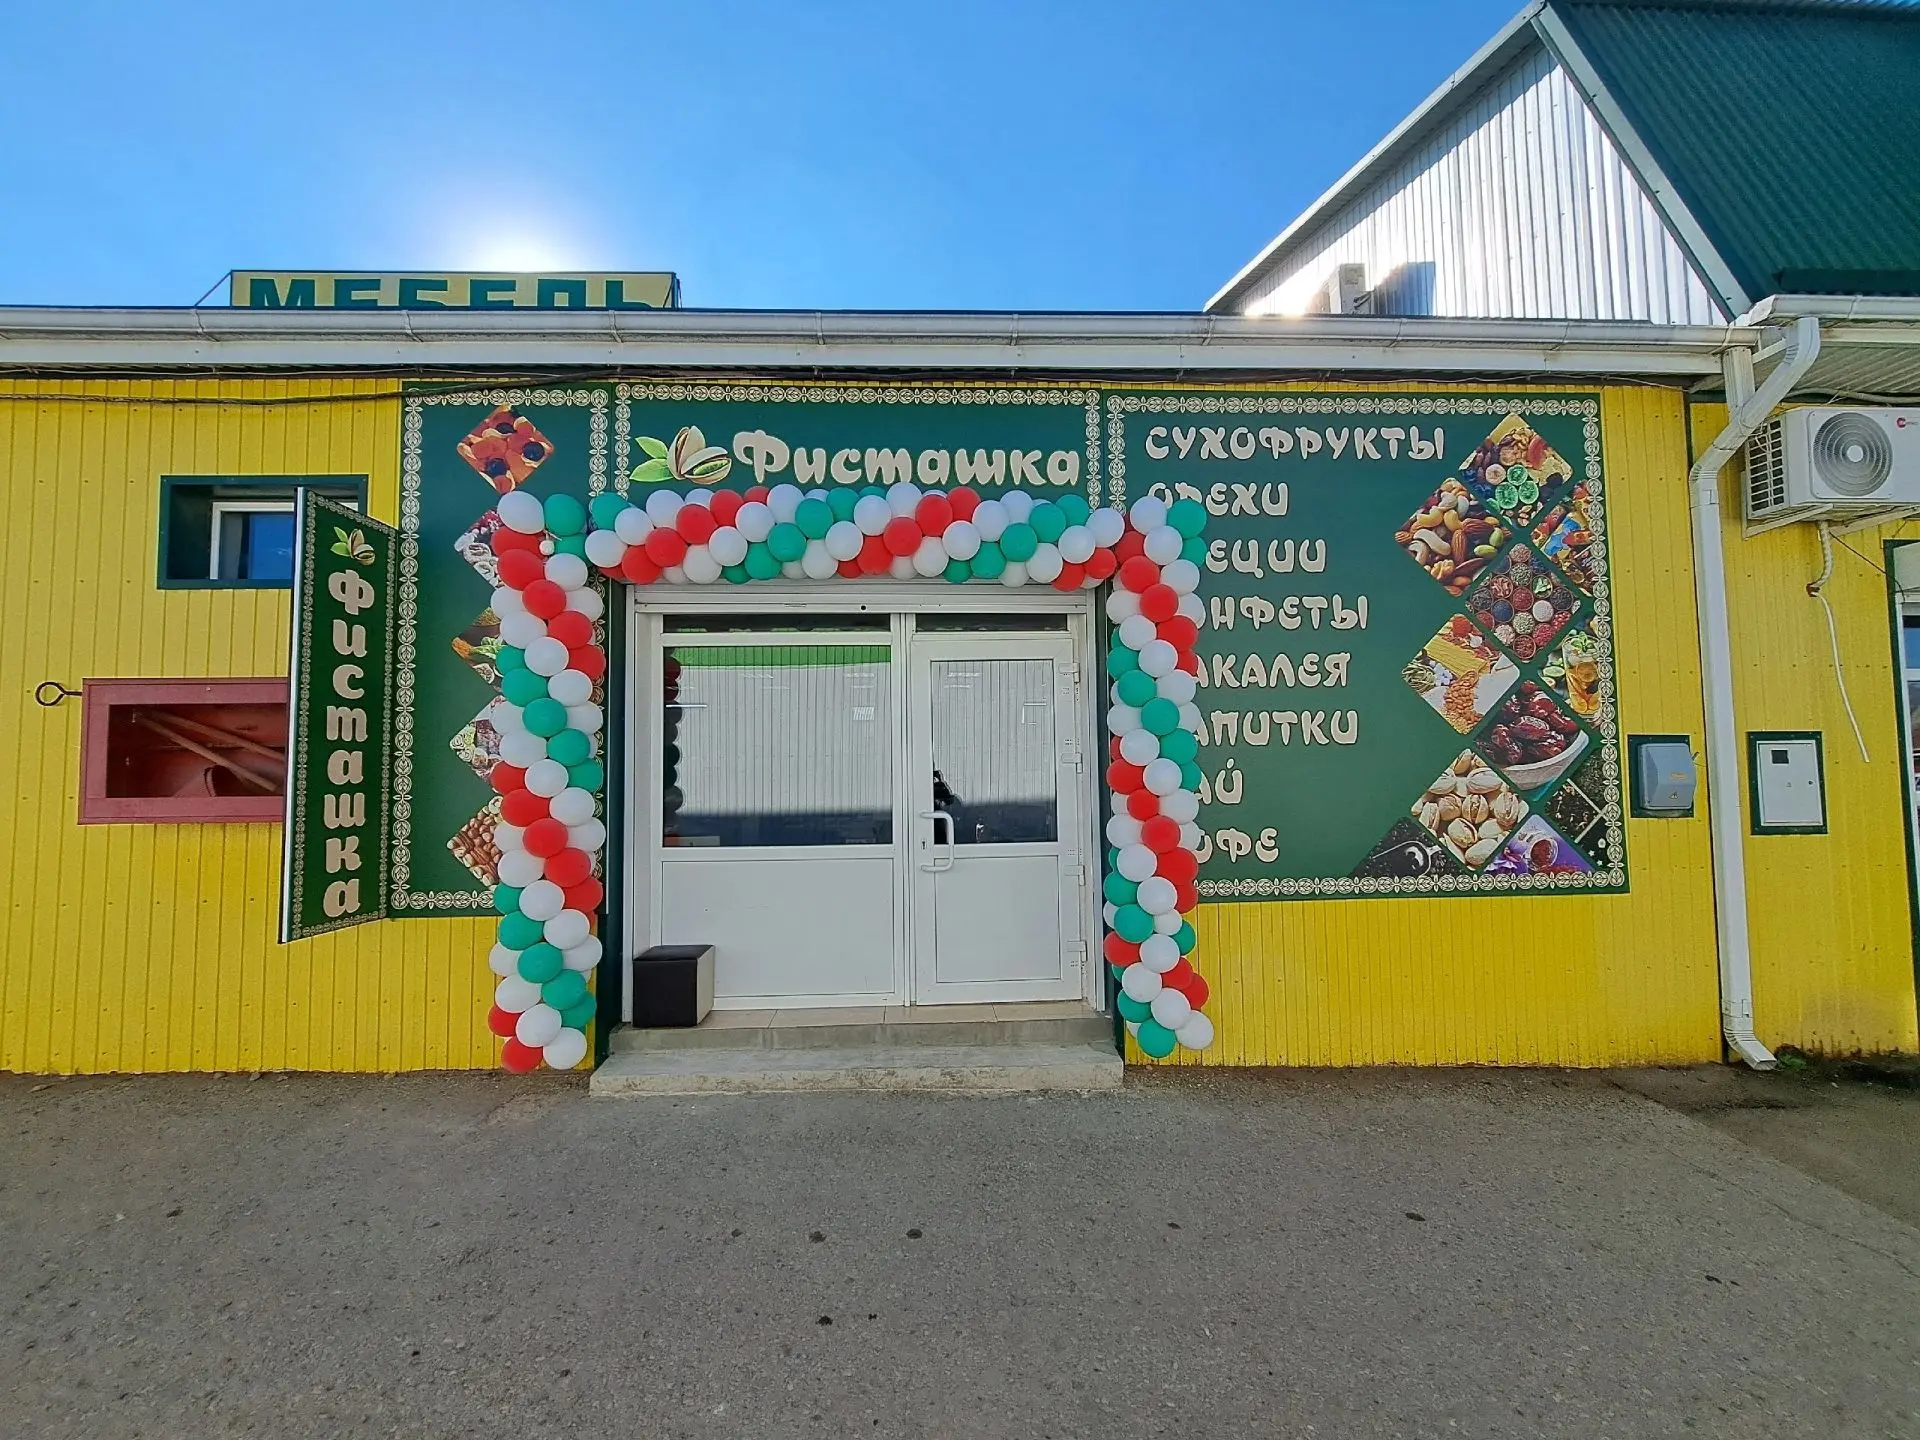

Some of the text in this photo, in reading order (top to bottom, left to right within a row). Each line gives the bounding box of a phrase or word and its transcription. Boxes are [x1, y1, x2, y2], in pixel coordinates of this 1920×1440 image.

[732, 428, 1080, 486] Фисташка
[1145, 425, 1446, 460] СУХОФРУКТЫ
[1205, 539, 1327, 579] ЕЦИИ
[1197, 594, 1369, 631] НФЕТЫ
[1194, 652, 1351, 688] АКАЛЕЯ
[321, 568, 376, 919] Фисташка
[1194, 709, 1359, 746] ПИТКИ
[1194, 827, 1279, 864] ОФЕ
